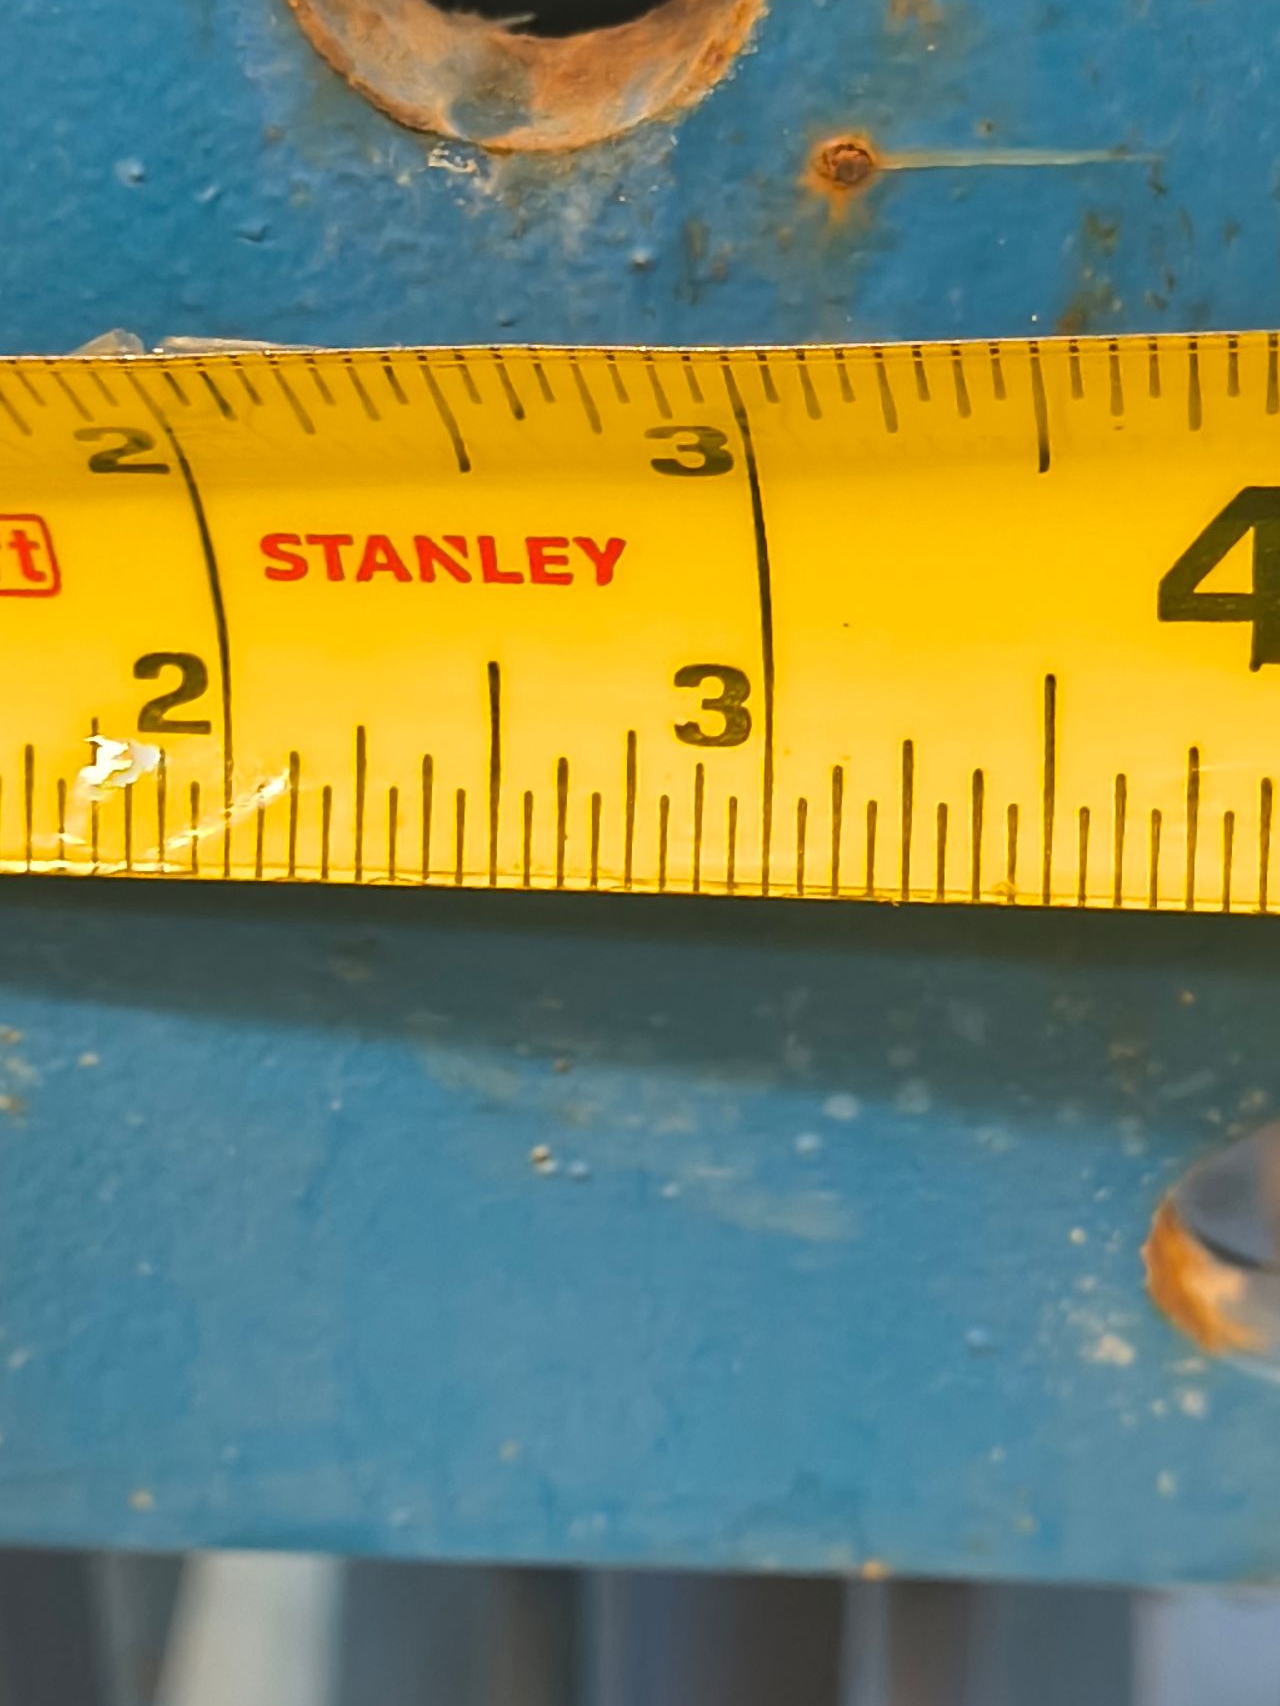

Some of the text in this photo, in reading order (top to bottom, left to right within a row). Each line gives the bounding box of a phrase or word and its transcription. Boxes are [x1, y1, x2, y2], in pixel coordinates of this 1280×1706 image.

[73, 426, 171, 474] 2
[644, 425, 735, 477] 3
[260, 532, 626, 586] STANLEY
[132, 652, 212, 735] 2
[673, 663, 752, 748] 3
